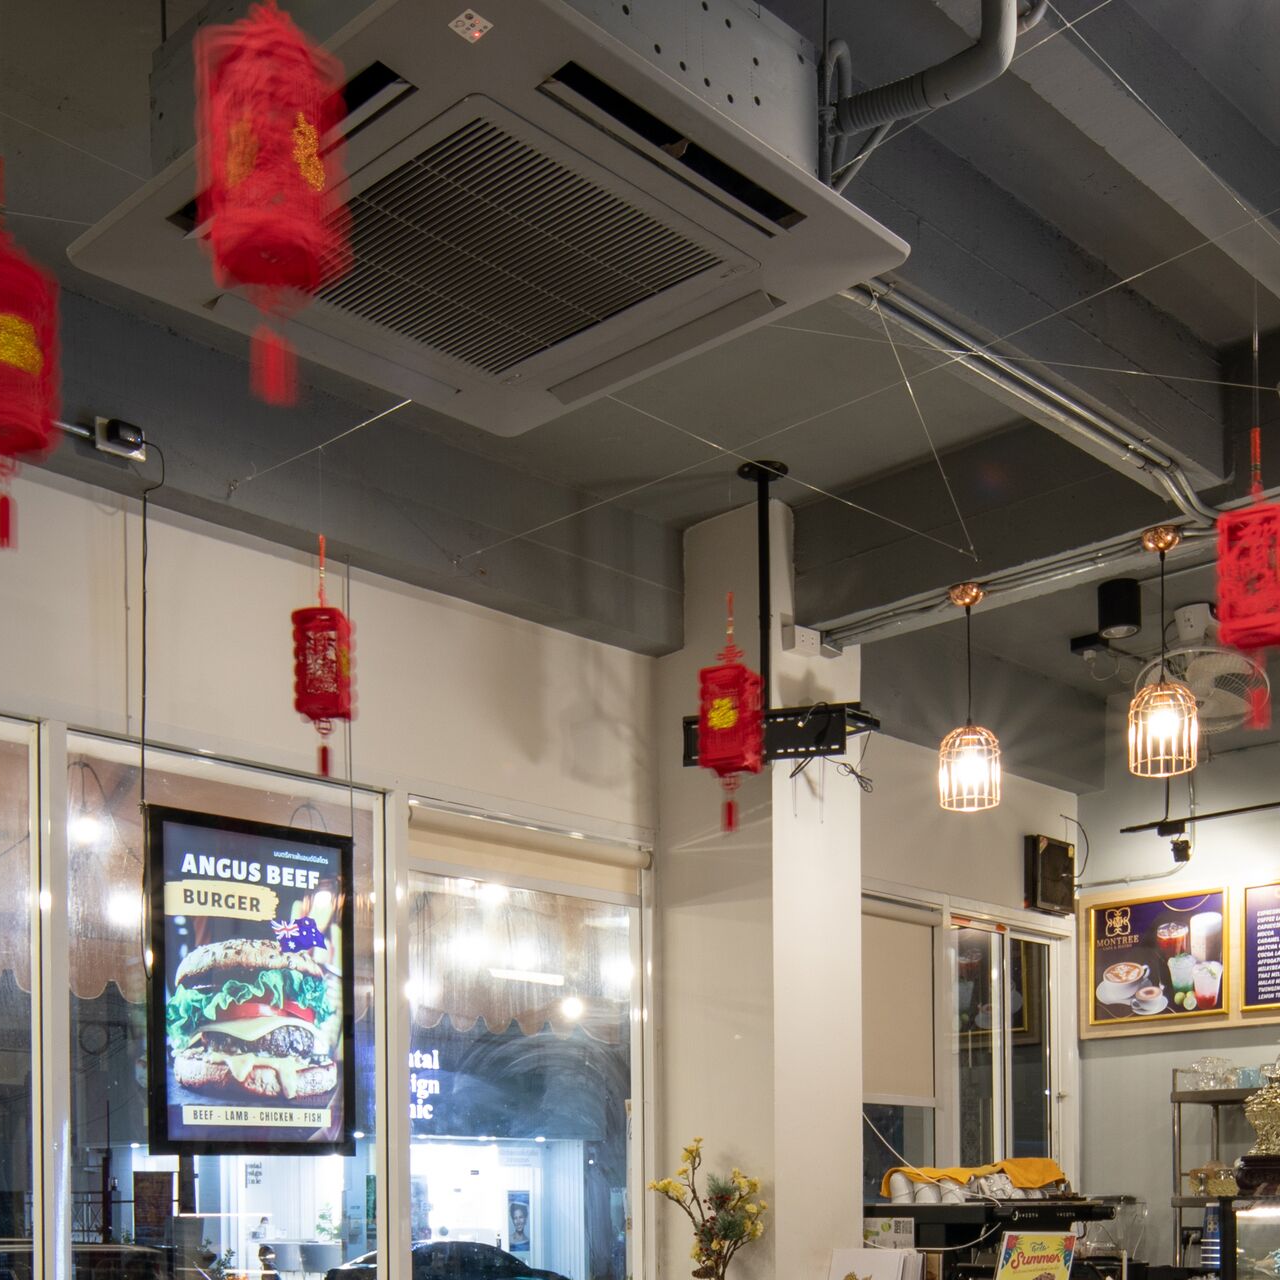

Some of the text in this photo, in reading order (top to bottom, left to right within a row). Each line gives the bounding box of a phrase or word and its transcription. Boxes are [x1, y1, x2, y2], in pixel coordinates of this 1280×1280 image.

[181, 852, 320, 890] ANGUS BEEF
[183, 887, 261, 913] BURGER
[1097, 935, 1139, 948] MONTREE
[193, 1110, 322, 1123] BEEF LAMB CHICKEN FISH
[1011, 1251, 1061, 1269] Summer
